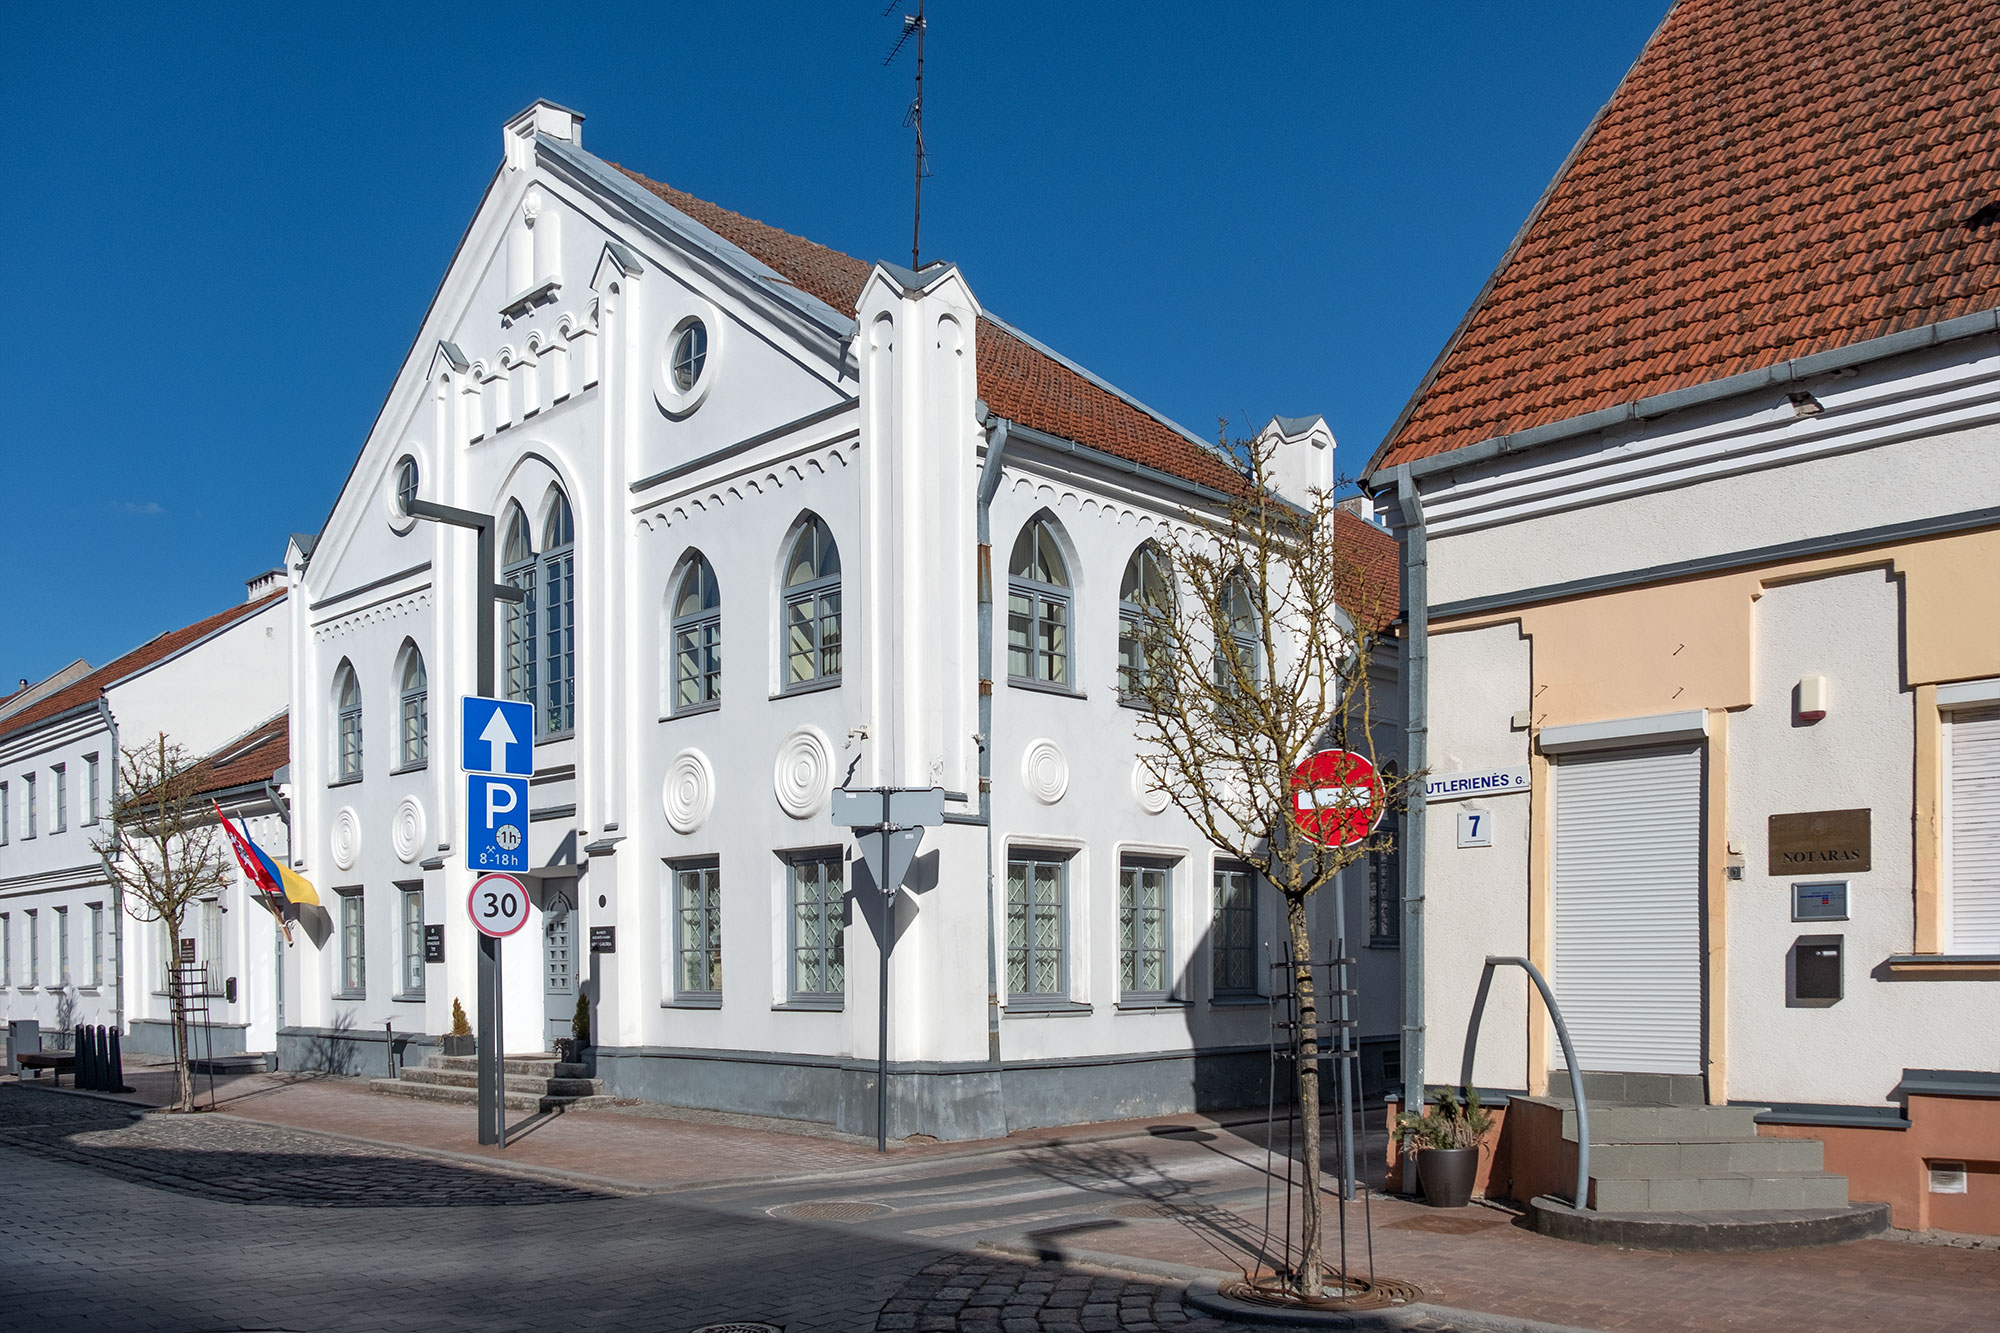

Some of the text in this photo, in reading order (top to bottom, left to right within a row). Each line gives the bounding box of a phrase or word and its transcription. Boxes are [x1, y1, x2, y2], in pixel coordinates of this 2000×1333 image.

[1426, 772, 1525, 794] UTLERIENĖS G.
[486, 782, 517, 829] P
[1468, 815, 1480, 837] 7
[501, 831, 517, 844] 1h
[1783, 849, 1860, 864] NOTARAS
[483, 892, 517, 918] 30
